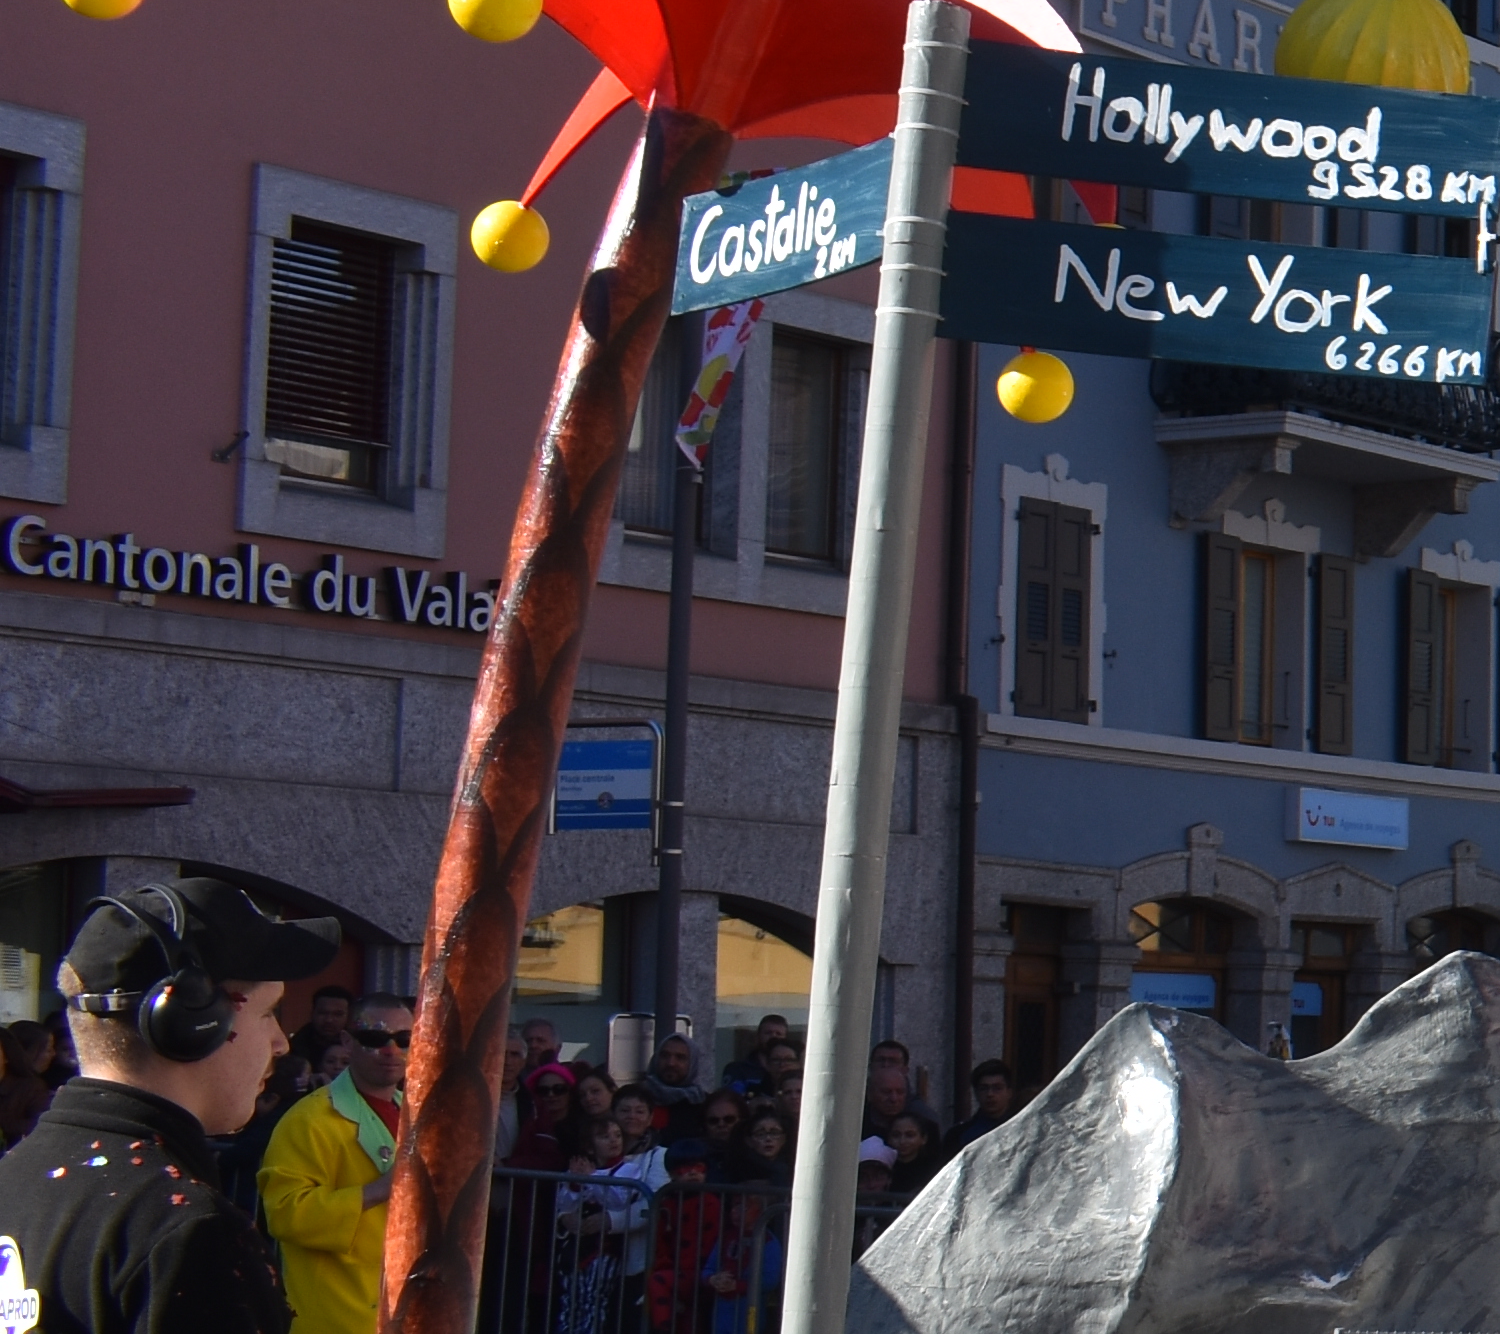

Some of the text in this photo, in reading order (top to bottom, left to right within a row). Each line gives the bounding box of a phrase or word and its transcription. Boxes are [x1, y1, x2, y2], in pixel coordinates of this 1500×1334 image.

[1062, 62, 1381, 162] Hollywood
[1307, 160, 1433, 203] 9528
[690, 180, 837, 284] Castalie
[813, 245, 828, 279] 2
[1055, 243, 1392, 335] New York
[1326, 336, 1427, 376] 6266
[8, 515, 498, 632] Cantonale du Vala
